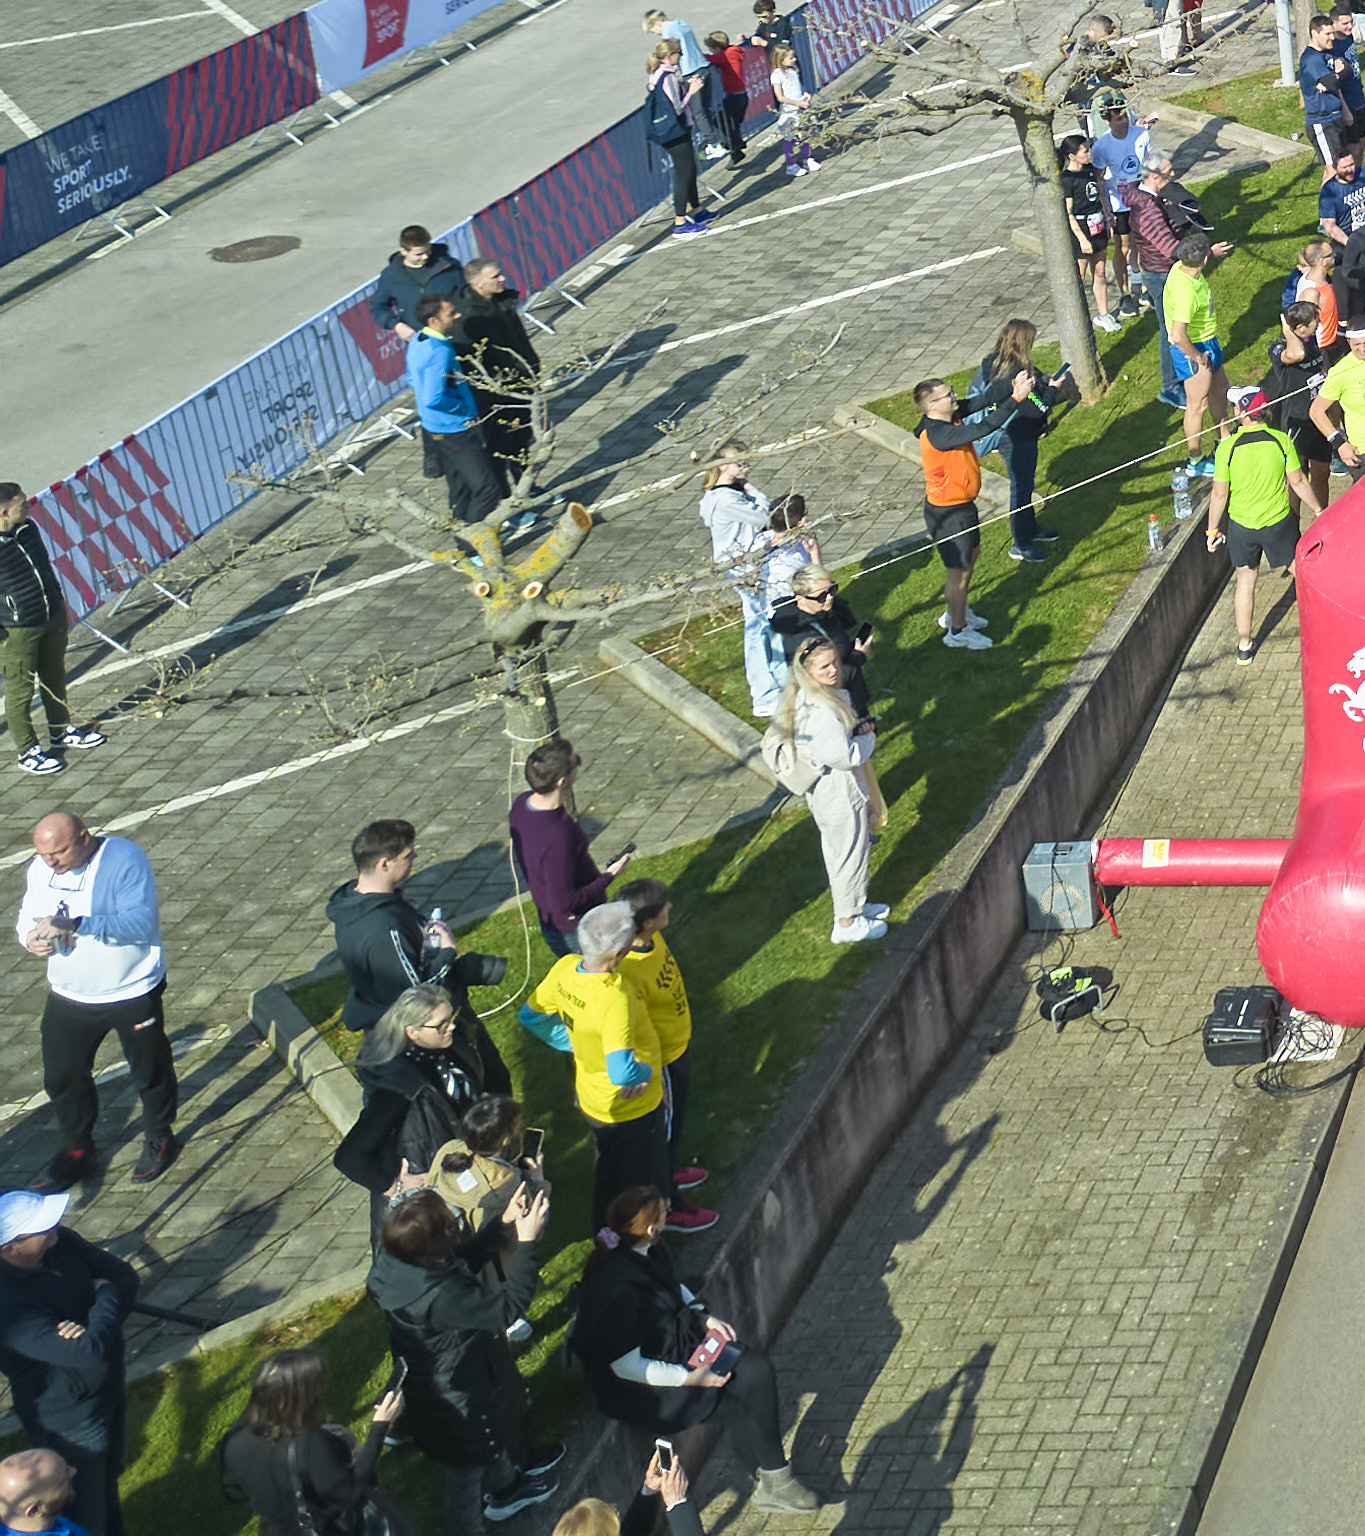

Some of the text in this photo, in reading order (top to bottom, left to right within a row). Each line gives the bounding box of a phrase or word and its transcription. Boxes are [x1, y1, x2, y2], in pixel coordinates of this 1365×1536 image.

[46, 154, 69, 174] WE
[53, 159, 92, 194] SPORT
[57, 165, 133, 214] SERIOUSLY.
